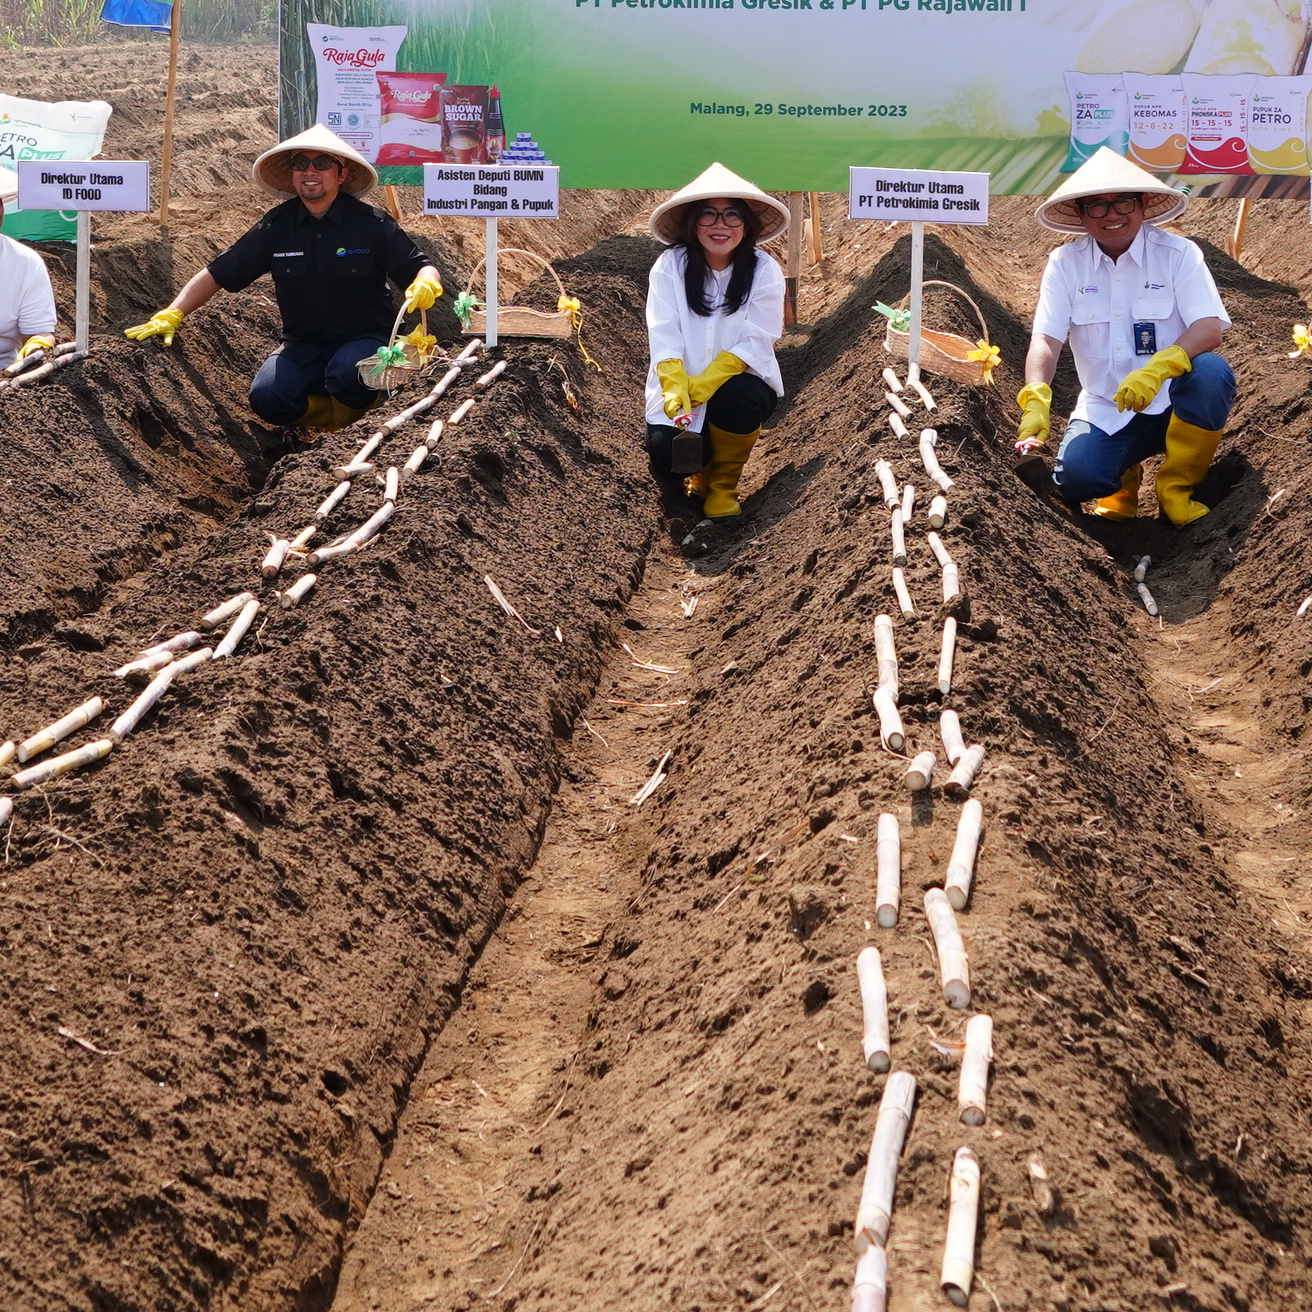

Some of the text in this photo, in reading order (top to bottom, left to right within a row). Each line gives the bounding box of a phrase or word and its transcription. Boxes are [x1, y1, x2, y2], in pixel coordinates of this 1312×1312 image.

[323, 48, 385, 67] Raja Gula
[391, 89, 412, 101] Raja
[411, 90, 431, 102] Gula
[445, 105, 482, 114] BROWN
[690, 102, 907, 120] Malang, 29 September 2023
[1076, 110, 1093, 119] ZA
[445, 113, 482, 121] SUGAR
[1252, 114, 1291, 124] PETRO
[21, 149, 62, 160] PLUS
[41, 172, 124, 185] Direktur Utama
[437, 169, 544, 183] Asisten Deputi BUMN
[473, 184, 507, 197] Bidang
[876, 179, 964, 195] Direktur Utama
[63, 188, 101, 200] ID FOOD
[427, 199, 554, 212] Industri Pangan & Pupuk
[859, 195, 980, 211] PT Petrokimia Gresik
